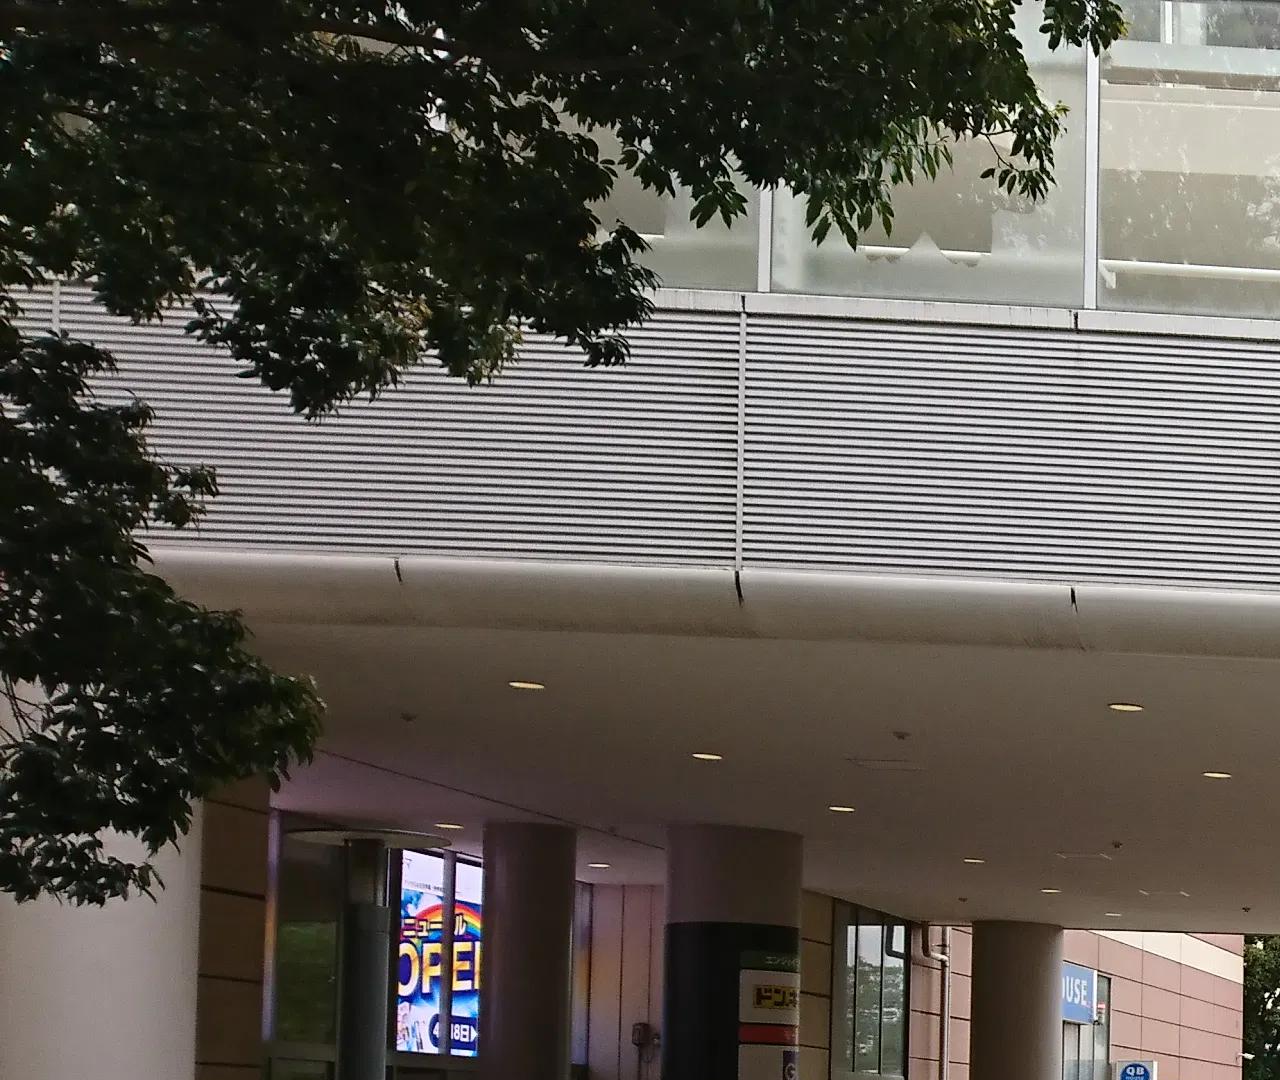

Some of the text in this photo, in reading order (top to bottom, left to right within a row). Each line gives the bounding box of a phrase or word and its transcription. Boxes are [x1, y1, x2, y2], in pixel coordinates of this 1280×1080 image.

[398, 942, 481, 997] OPE
[1062, 974, 1088, 1006] USE
[1126, 1066, 1145, 1076] QB
